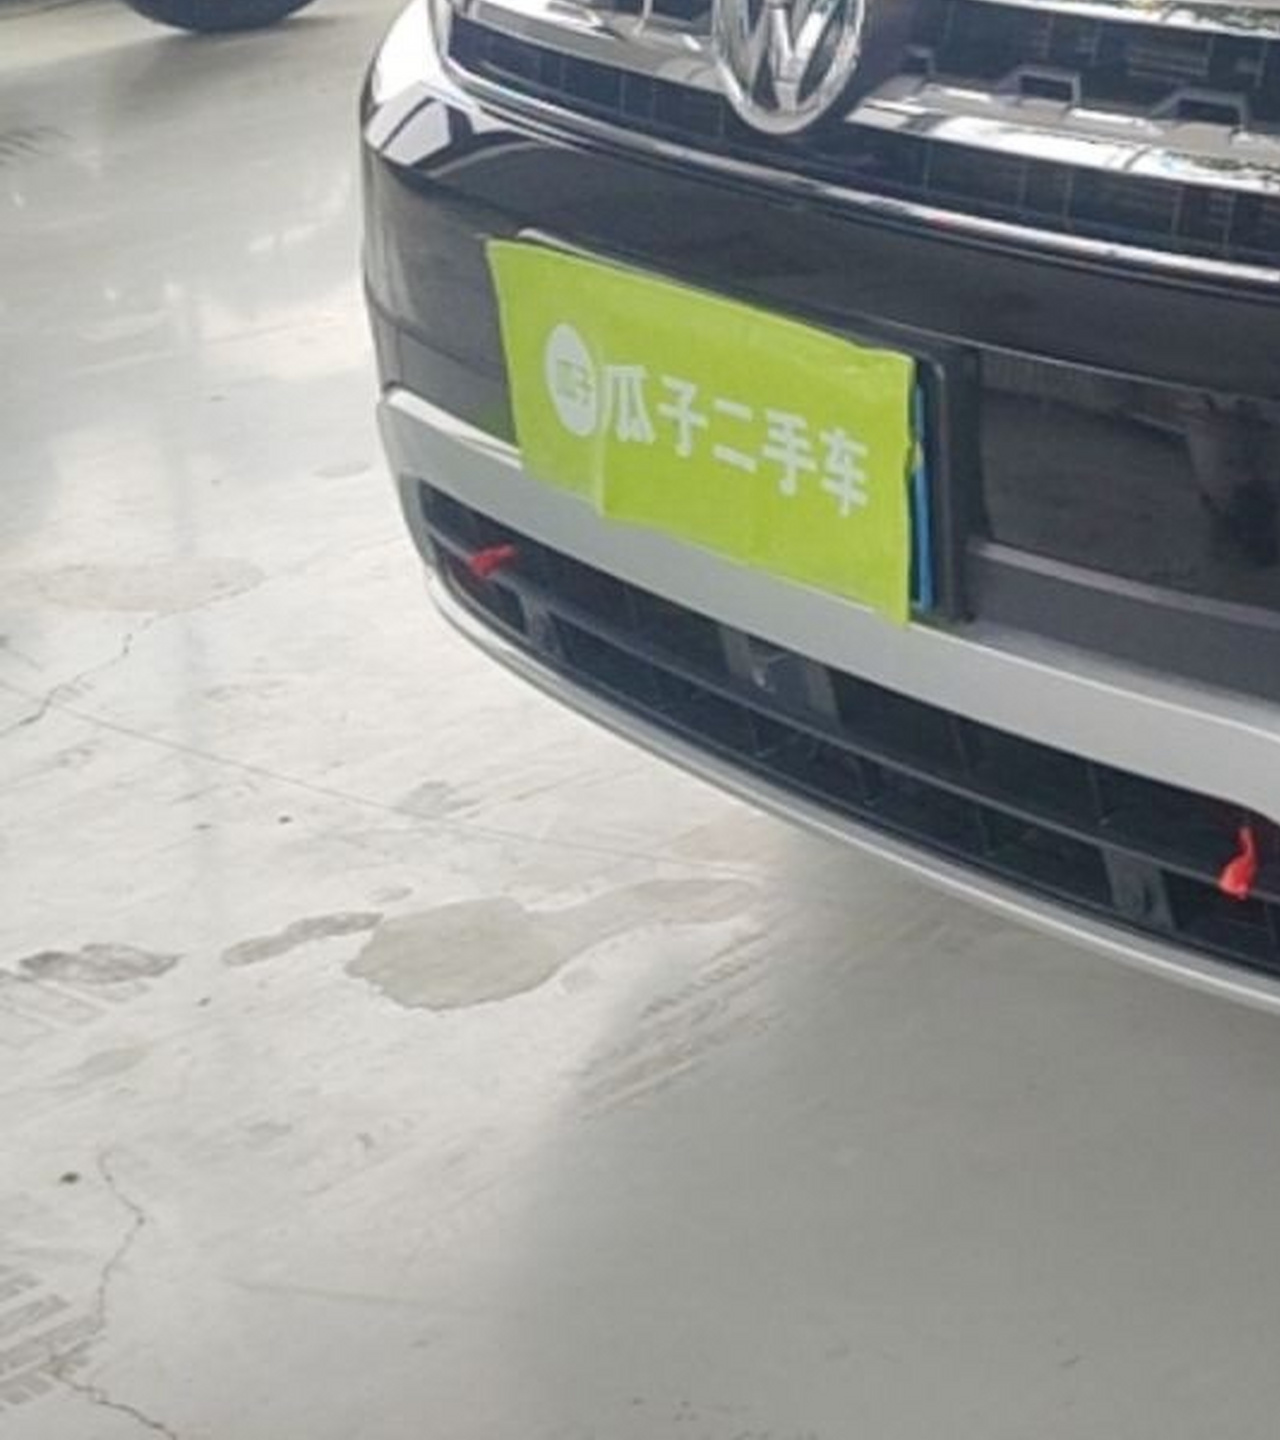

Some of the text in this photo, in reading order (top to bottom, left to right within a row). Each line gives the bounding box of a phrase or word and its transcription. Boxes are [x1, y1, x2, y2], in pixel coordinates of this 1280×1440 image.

[602, 363, 869, 518] 瓜子二手车
